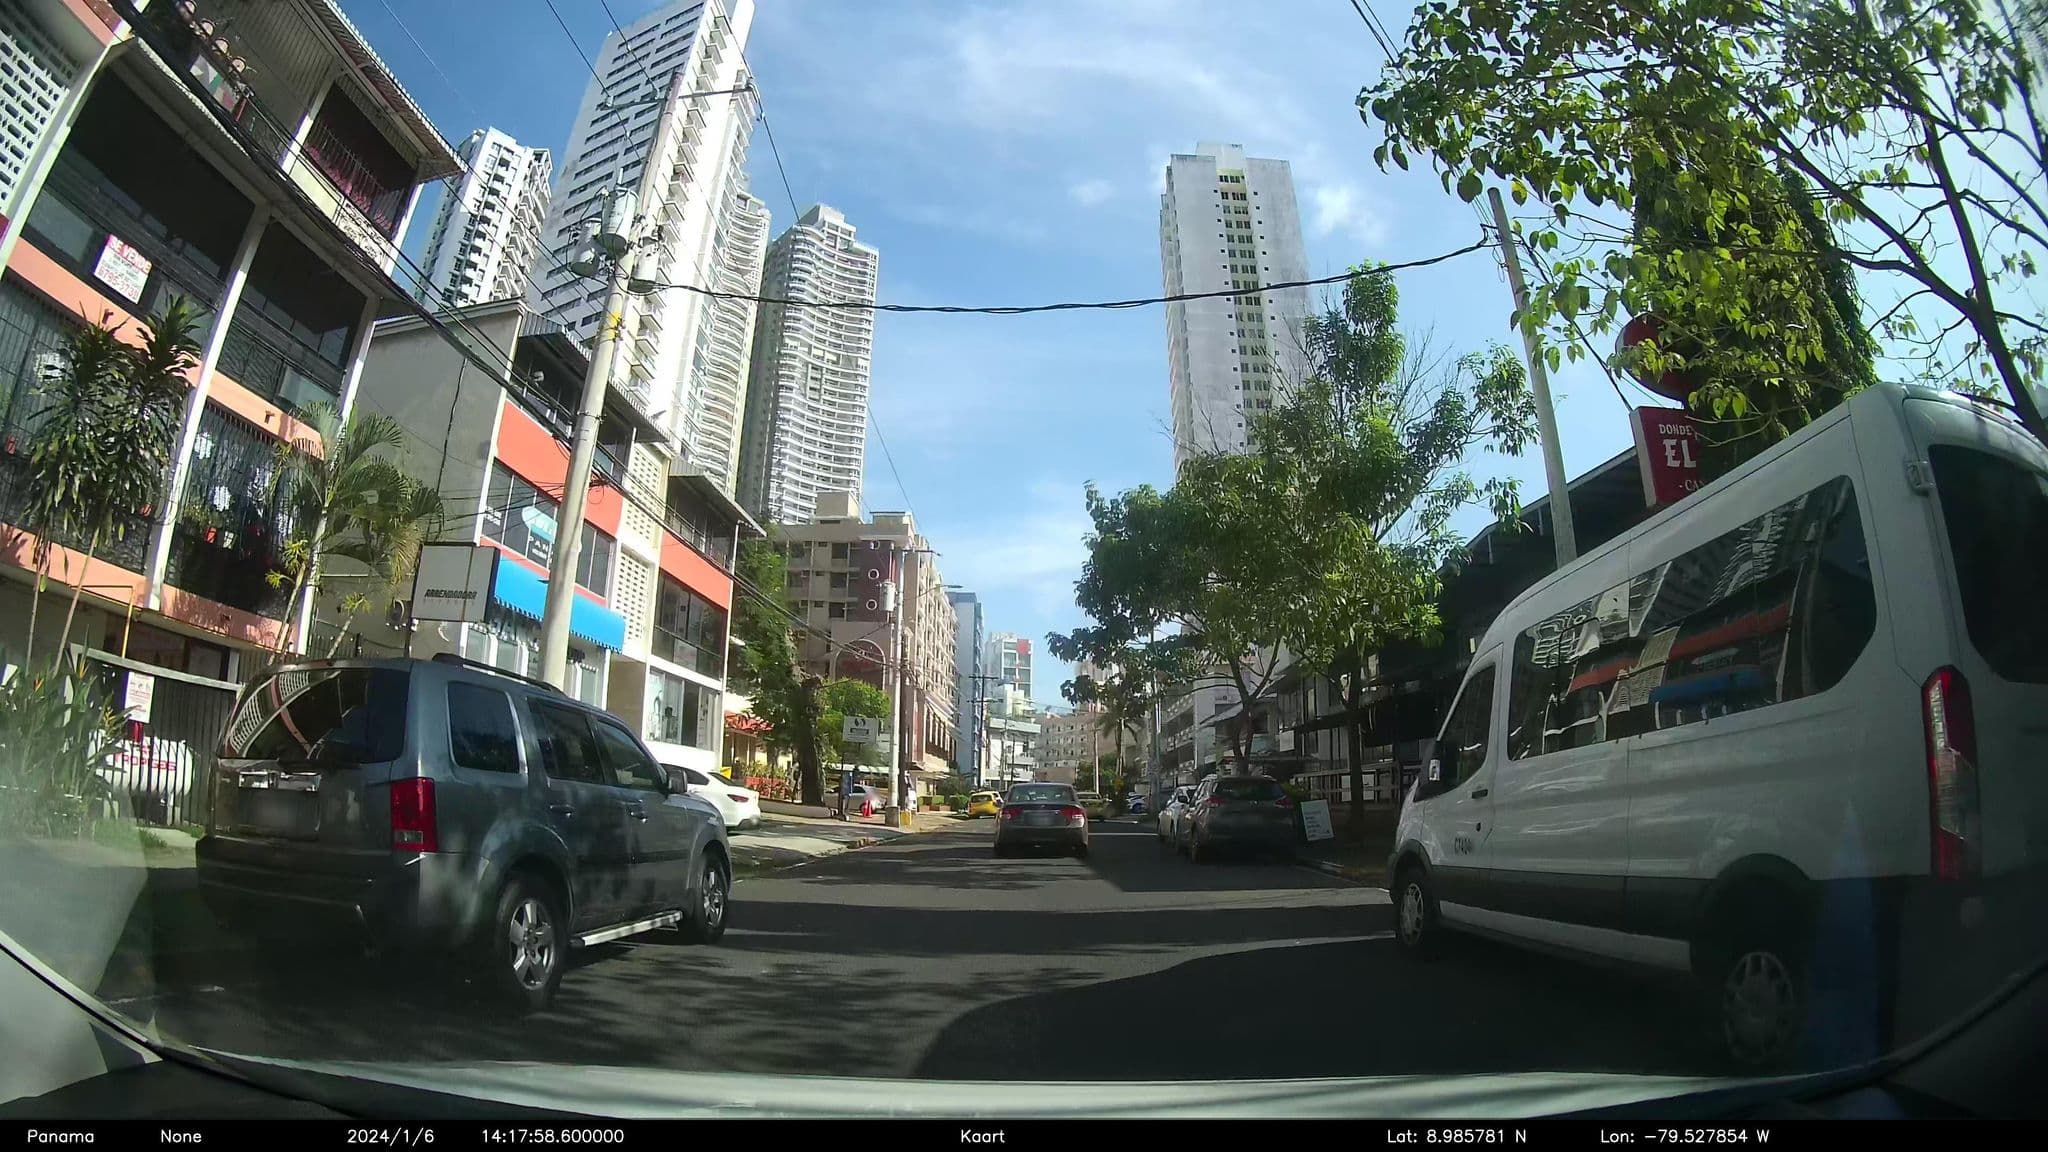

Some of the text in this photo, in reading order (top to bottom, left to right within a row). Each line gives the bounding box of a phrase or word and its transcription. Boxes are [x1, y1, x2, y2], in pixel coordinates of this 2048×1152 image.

[104, 235, 125, 255] SE
[120, 244, 153, 275] VENDE
[1658, 423, 1693, 436] DONDE
[1662, 438, 1697, 468] EL
